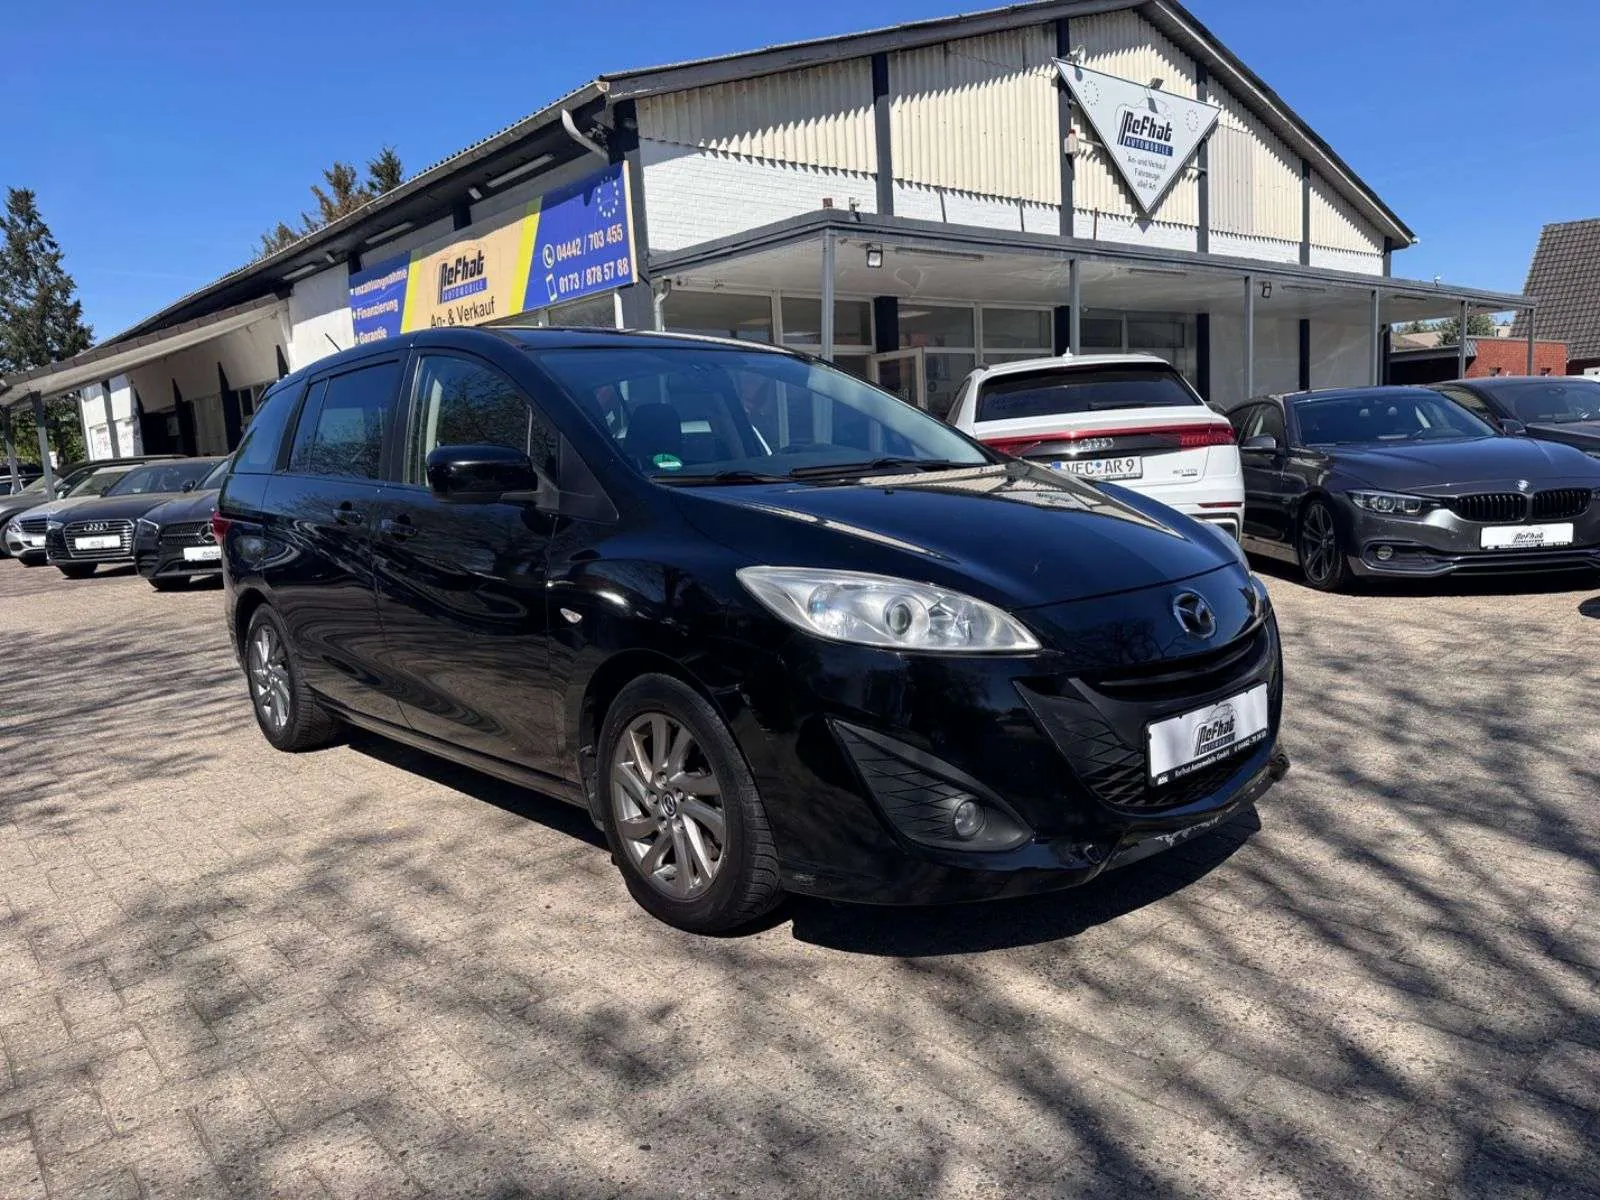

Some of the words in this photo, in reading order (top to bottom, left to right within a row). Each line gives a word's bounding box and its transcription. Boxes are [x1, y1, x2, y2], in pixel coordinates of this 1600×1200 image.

[556, 238, 582, 262] 04442
[588, 229, 605, 251] 703
[606, 223, 623, 244] 455
[559, 272, 580, 293] 0173
[586, 265, 603, 286] 878
[603, 261, 615, 280] 57
[616, 257, 629, 277] 88
[443, 279, 486, 302] AUTOMOBILE
[357, 298, 399, 320] Finanzierung
[431, 314, 446, 329] An-
[447, 308, 455, 326] &
[456, 295, 495, 322] Verkauf
[1104, 460, 1122, 474] AR
[1125, 459, 1135, 472] 9
